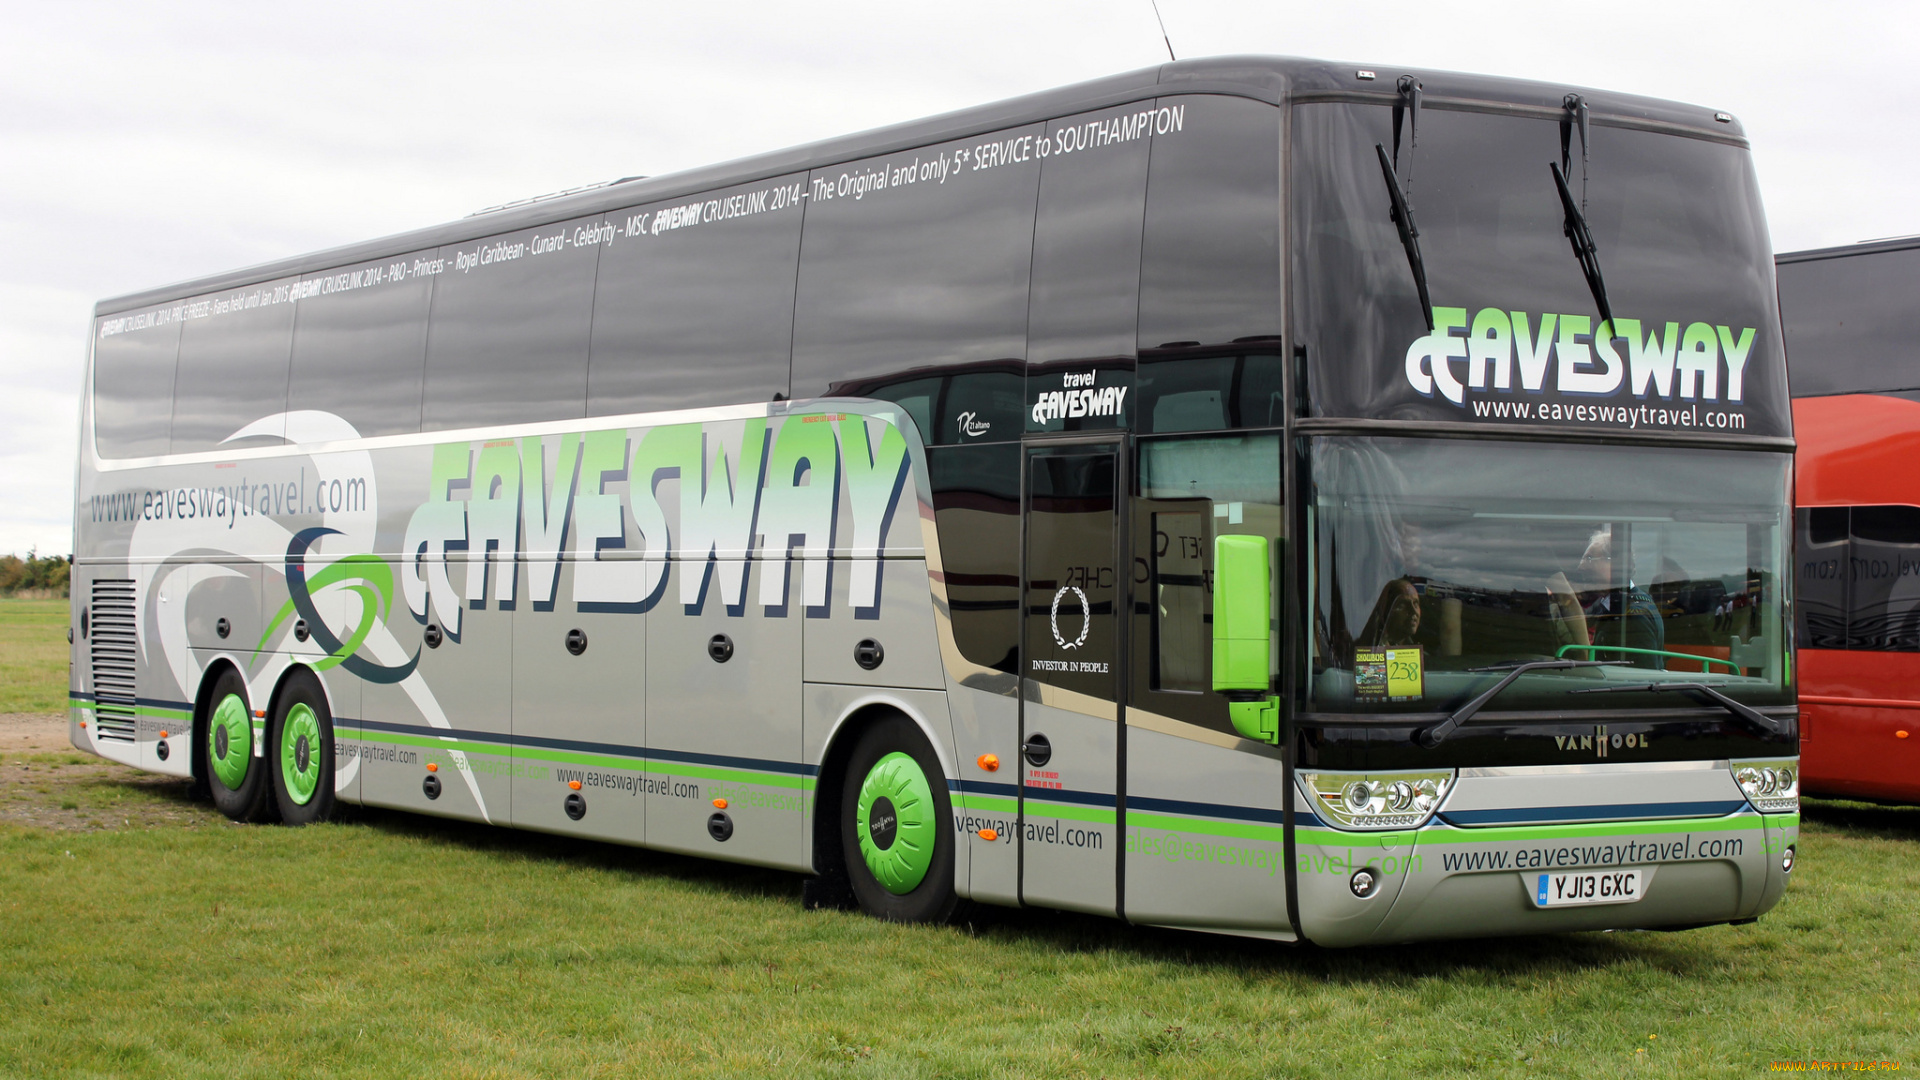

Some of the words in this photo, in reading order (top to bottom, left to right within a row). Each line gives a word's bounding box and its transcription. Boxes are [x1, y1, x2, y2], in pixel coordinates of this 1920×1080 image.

[156, 308, 172, 326] 2014
[171, 305, 188, 324] PRICE
[187, 300, 210, 320] FREEZE
[213, 299, 230, 315] Fares
[229, 292, 246, 312] held
[244, 289, 261, 309] until
[260, 290, 272, 307] Jan
[272, 285, 290, 304] 2015
[321, 270, 364, 295] CRUISELINK
[363, 267, 382, 288] 2014
[388, 263, 406, 283] P&O
[412, 257, 444, 279] Princess
[455, 248, 478, 274] Royal
[480, 241, 524, 267] Caribbean
[531, 229, 565, 256] Cunard
[573, 220, 617, 249] Celebrity
[625, 213, 649, 238] MSC
[651, 203, 705, 236] EAVESWAY
[702, 189, 767, 224] CRUISELINK
[770, 183, 800, 211] 2014
[813, 179, 835, 203] The
[837, 163, 890, 201] Original
[890, 157, 918, 185] and
[920, 152, 951, 184] only
[972, 135, 1033, 171] SERVICE
[1034, 135, 1052, 158] to
[1054, 104, 1185, 155] SOUTHAMPTON
[1405, 305, 1758, 408] EAVESWAY
[1063, 369, 1096, 388] travel
[1032, 386, 1128, 426] EAVESWAY
[1472, 400, 1746, 430] www.eaveswaytravel.com
[91, 466, 367, 529] www.eaveswaytravel.com
[401, 411, 911, 644] EAVESWAY
[1032, 659, 1068, 672] INVESTOR
[1069, 661, 1078, 672] IN
[1079, 661, 1109, 673] PEOPLE
[1389, 661, 1419, 682] 238
[423, 750, 550, 780] sales@eaveswaytravel.com
[556, 768, 699, 799] www.eaveswaytravel.com
[707, 781, 815, 818] sales@eavesway
[1442, 833, 1744, 872] www.eaveswaytravel.com
[1759, 829, 1799, 855] sale
[1556, 875, 1596, 900] YJ13
[1600, 874, 1635, 897] GXC
